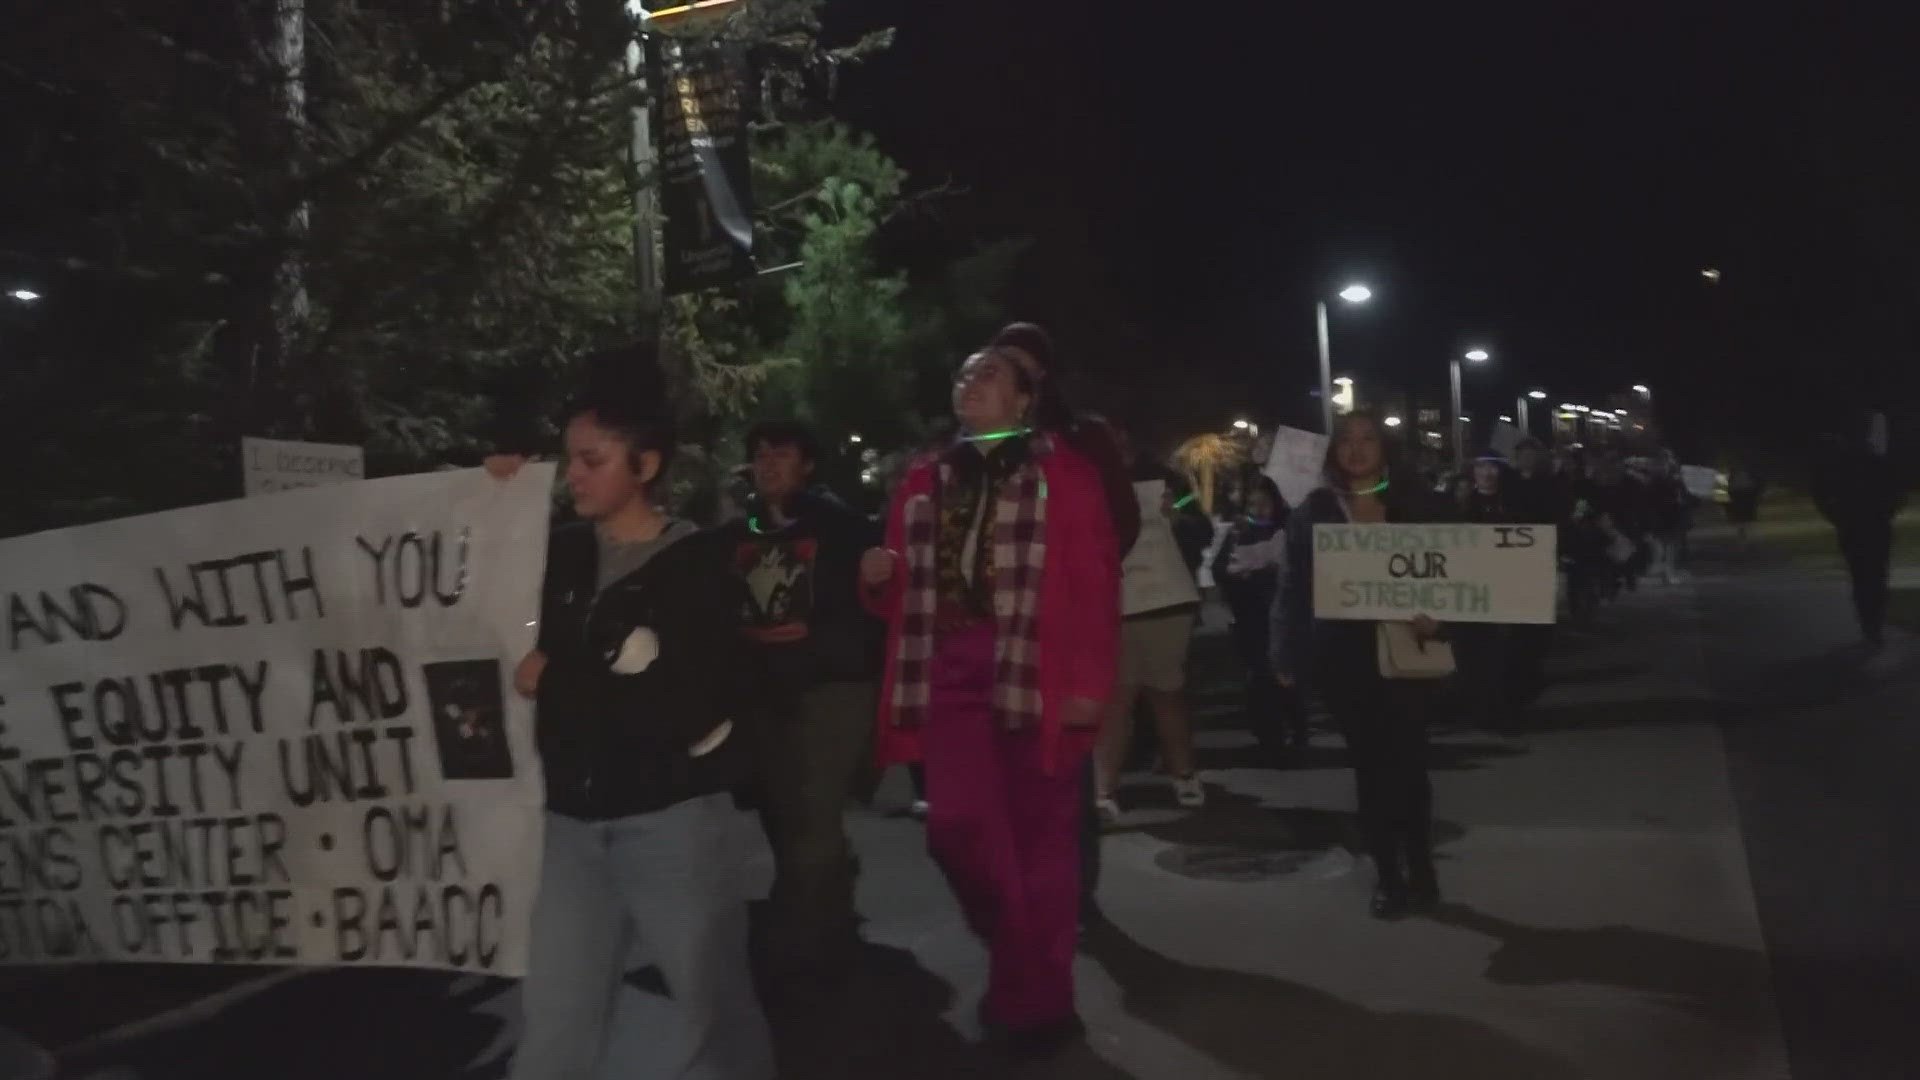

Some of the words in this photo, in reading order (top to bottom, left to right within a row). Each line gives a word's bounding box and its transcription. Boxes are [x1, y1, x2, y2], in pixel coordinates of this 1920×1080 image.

[155, 547, 325, 629] WITH
[356, 526, 471, 608] YOU
[1317, 527, 1481, 551] DIVERSITY
[1493, 527, 1536, 549] IS
[1388, 551, 1449, 579] OUR
[1340, 580, 1492, 614] STRENGTH
[50, 661, 268, 750] EQUITY
[307, 646, 409, 729] AND
[278, 727, 416, 808] UNIT
[99, 812, 291, 891] CENTER
[364, 803, 469, 883] OMA
[112, 890, 299, 963] OFFICE
[333, 883, 502, 968] BAACC
